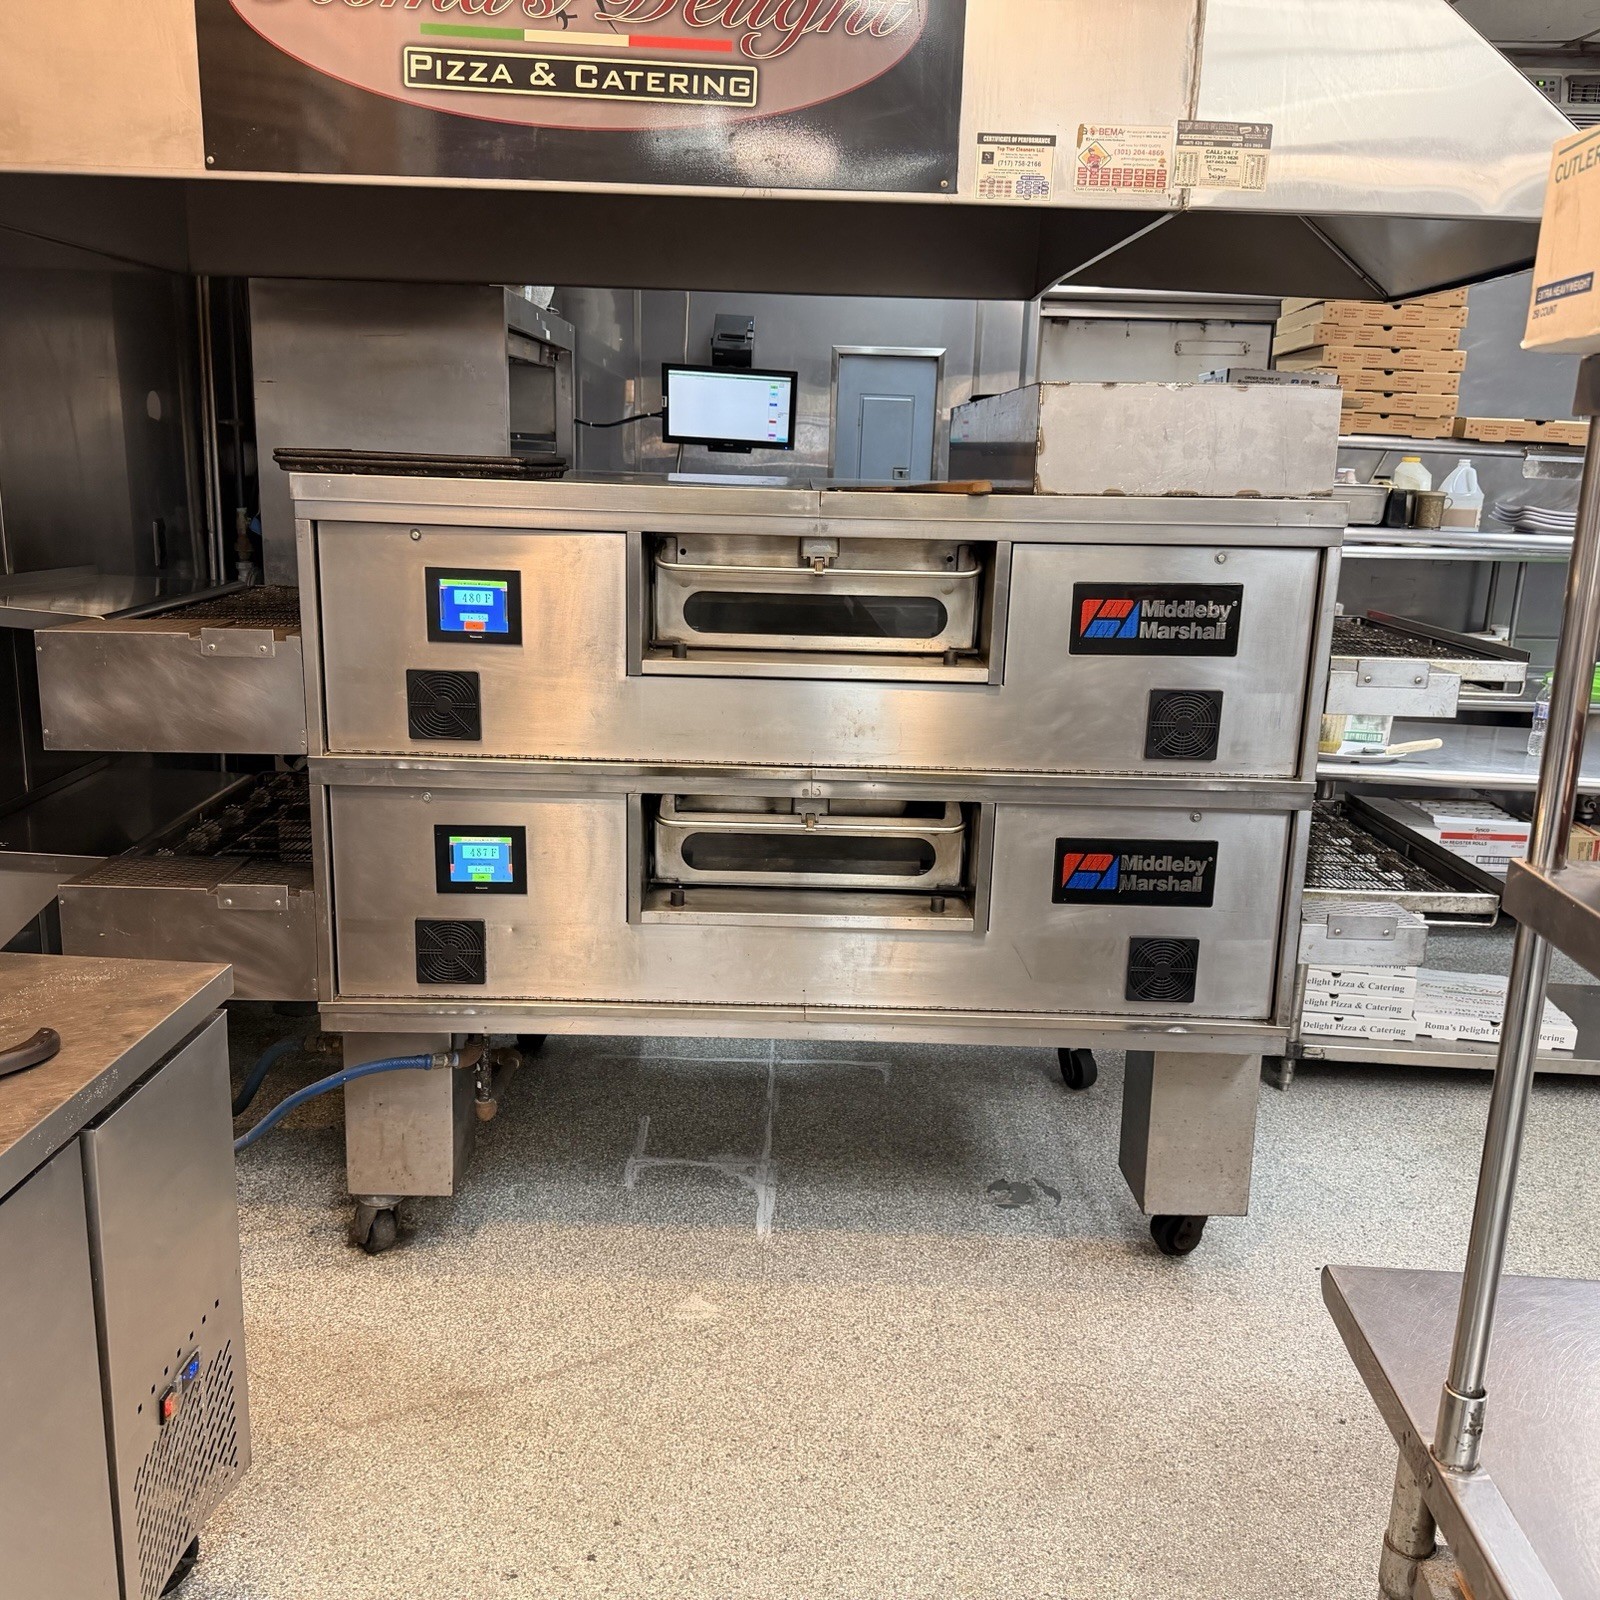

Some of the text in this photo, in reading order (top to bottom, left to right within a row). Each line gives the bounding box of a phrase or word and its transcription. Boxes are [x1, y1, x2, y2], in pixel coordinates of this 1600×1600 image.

[595, 0, 913, 59] eigt
[409, 53, 751, 97] PIZZA & CATERING
[983, 135, 1011, 143] CERTIFICATE
[1018, 136, 1051, 144] PERFORMANCE
[1139, 621, 1226, 640] Marshall
[1119, 874, 1203, 893] Marshall
[1306, 978, 1405, 993] elight Pizza & Catering
[1304, 999, 1328, 1007] elight
[1330, 1000, 1352, 1009] Pizza
[1365, 1003, 1402, 1014] Catering
[1302, 1021, 1333, 1030] Delight
[1335, 1023, 1357, 1032] Pizza
[1369, 1025, 1406, 1036] Catering
[1424, 1021, 1457, 1032] Roma's
[1458, 1022, 1489, 1036] Delight
[1538, 1033, 1565, 1044] tering
